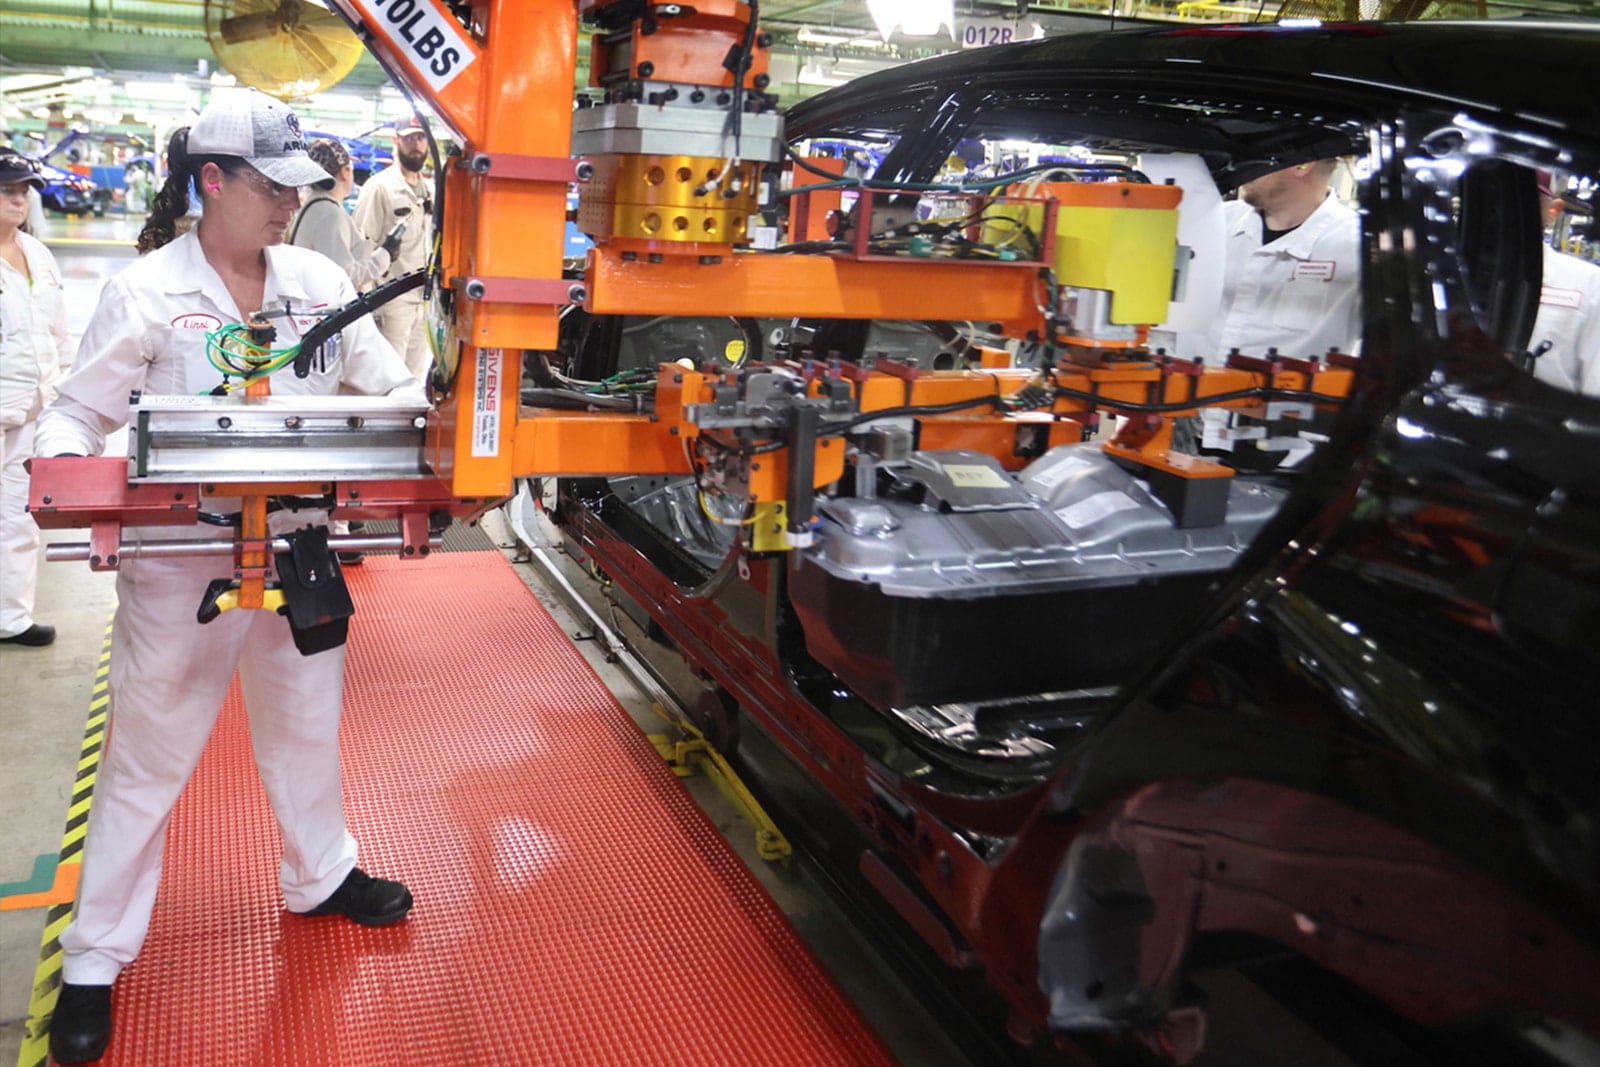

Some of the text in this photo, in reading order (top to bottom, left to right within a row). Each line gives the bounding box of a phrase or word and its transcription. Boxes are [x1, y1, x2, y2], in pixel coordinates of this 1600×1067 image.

[374, 0, 460, 77] 0LBS
[965, 25, 1012, 45] 012R
[486, 347, 500, 411] GIVENS
